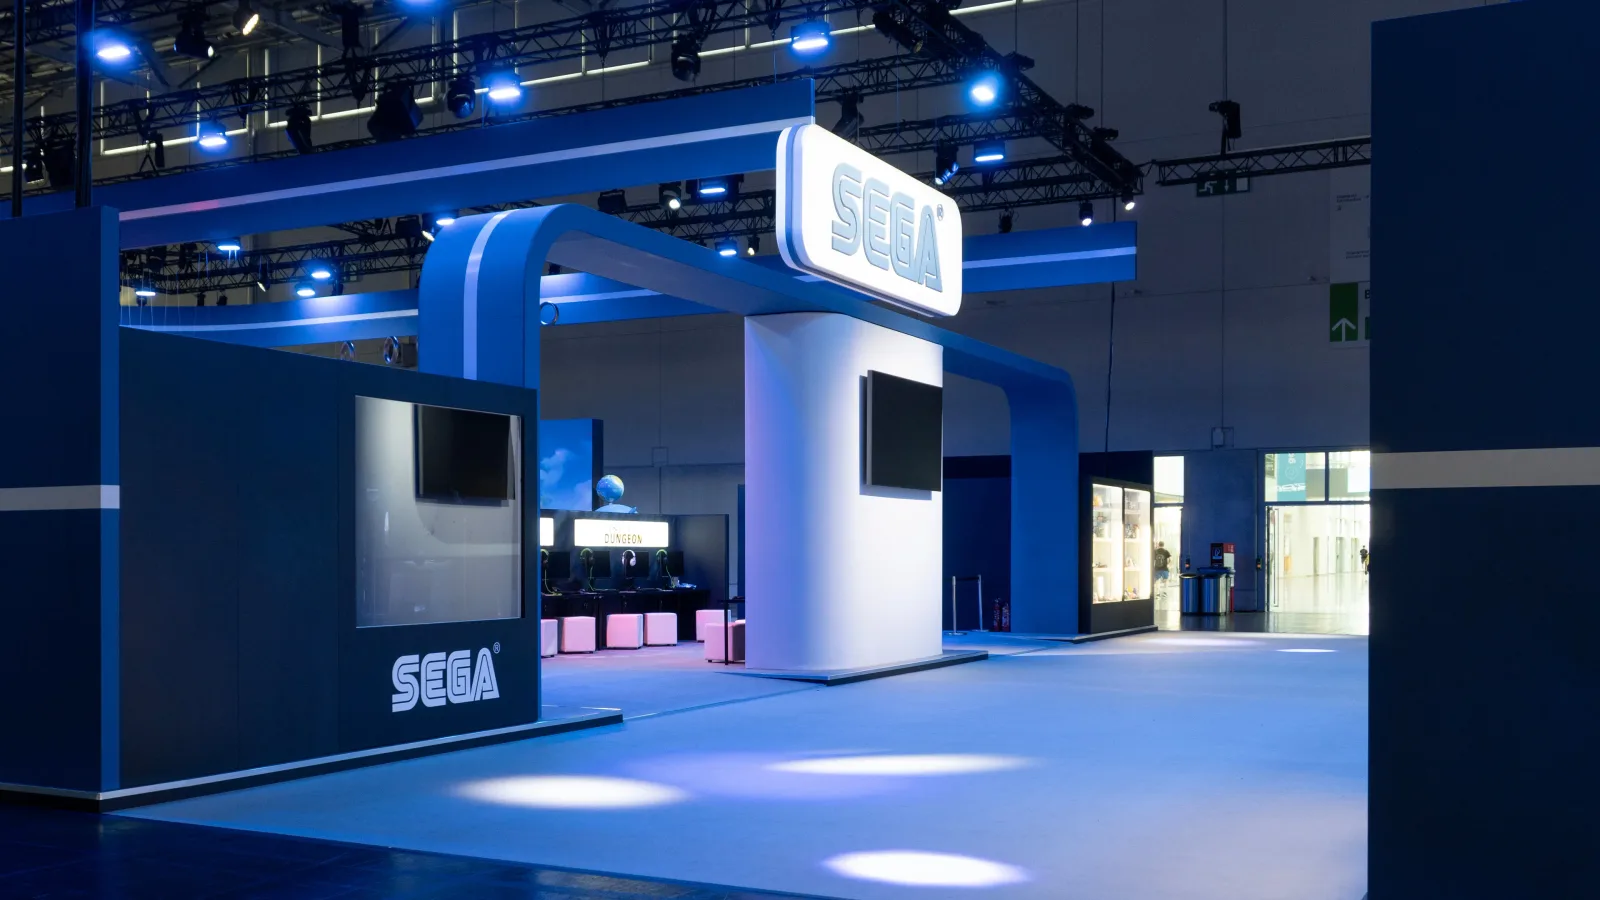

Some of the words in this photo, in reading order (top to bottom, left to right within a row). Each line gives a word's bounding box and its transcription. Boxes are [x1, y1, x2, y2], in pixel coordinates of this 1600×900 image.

[832, 162, 943, 293] SEGA
[604, 533, 643, 544] DUNGEON
[392, 647, 500, 713] SEGA
